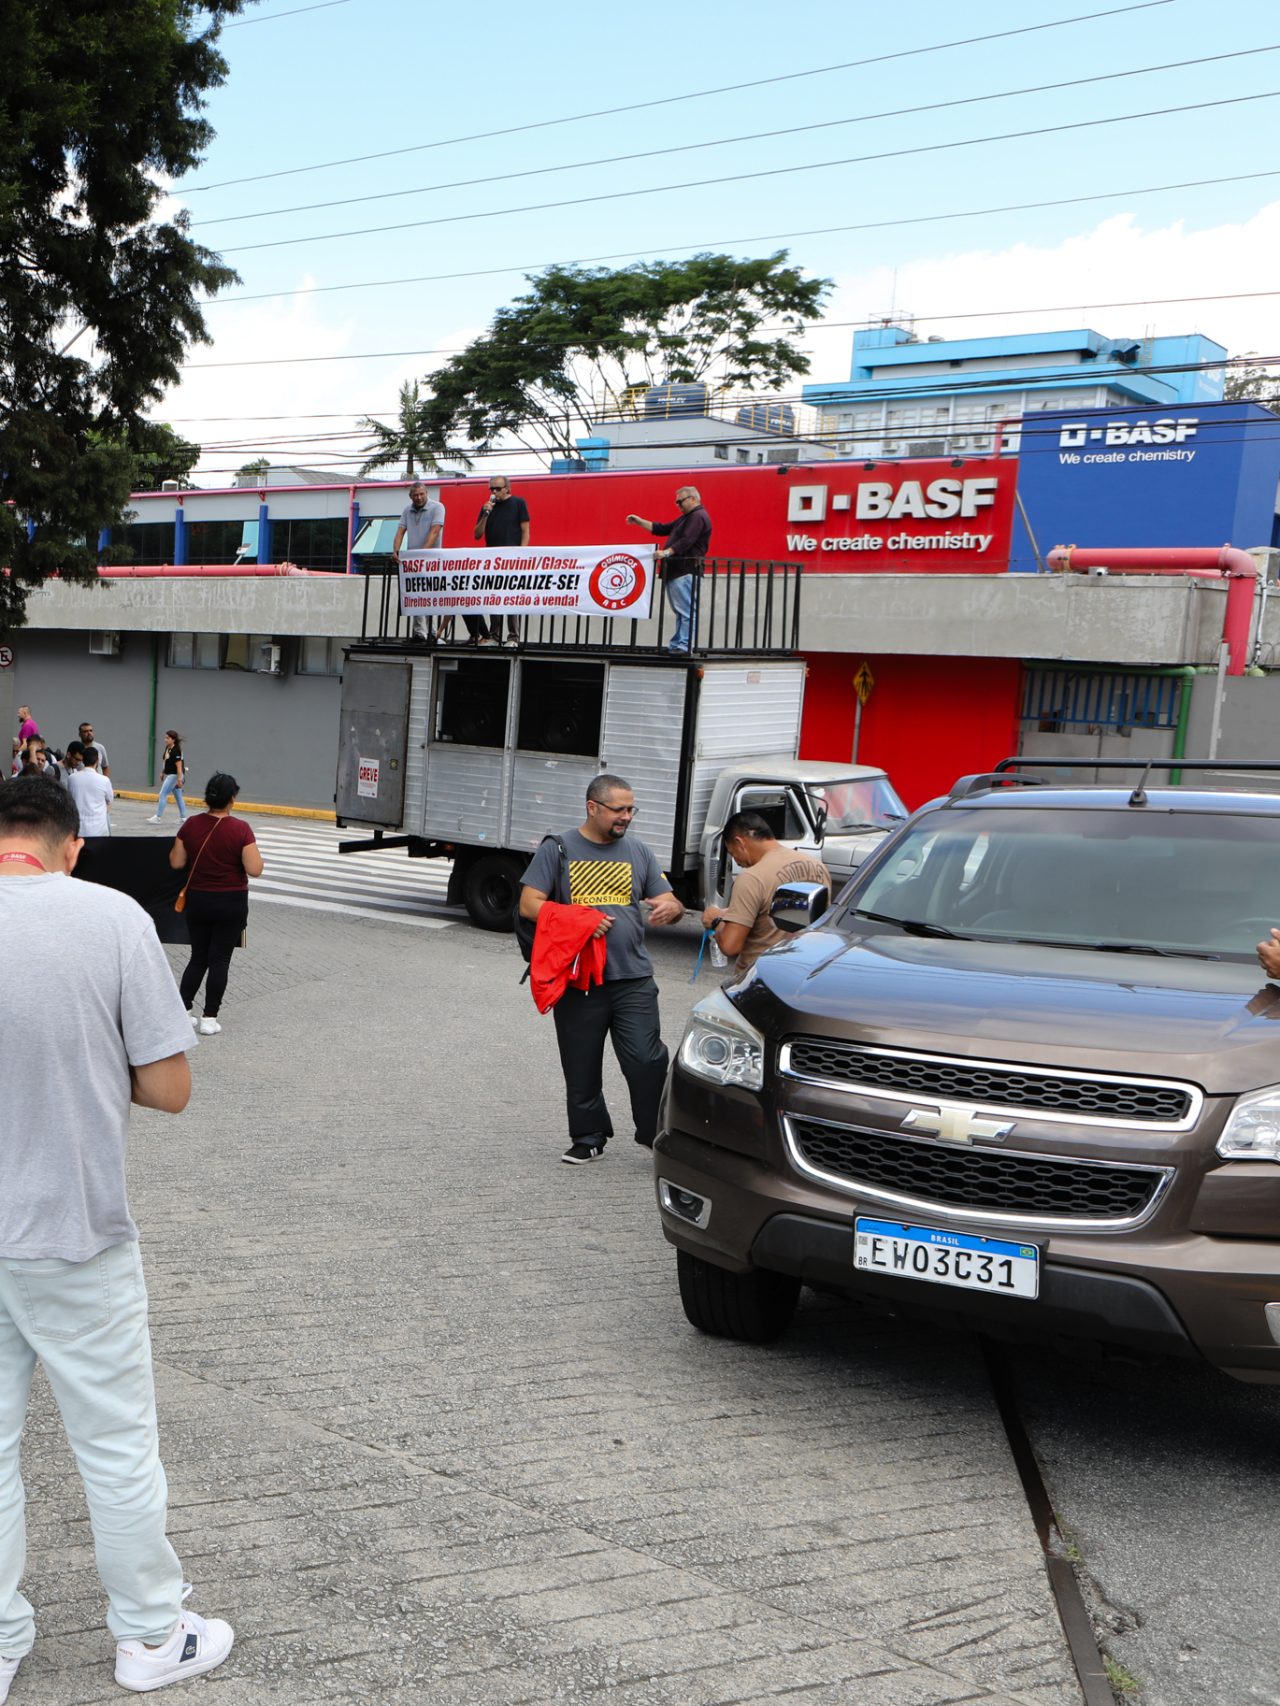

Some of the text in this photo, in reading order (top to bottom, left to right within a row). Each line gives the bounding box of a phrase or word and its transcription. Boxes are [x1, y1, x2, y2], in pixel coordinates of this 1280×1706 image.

[1105, 418, 1199, 445] BASF
[1059, 449, 1196, 464] We create chemistry
[856, 478, 998, 520] BASF
[786, 531, 993, 553] We create chemistry
[402, 559, 425, 573] BASF
[426, 558, 441, 572] vai
[442, 557, 483, 571] vender
[483, 559, 491, 570] a
[405, 574, 581, 592] DEFENDA-SE! SINDICALIZE-SE!
[404, 595, 432, 608] Direitos
[432, 597, 438, 606] e
[439, 596, 481, 608] empregos
[483, 594, 502, 606] não
[503, 594, 532, 606] estão
[542, 594, 579, 606] venda!
[360, 766, 378, 782] GREVE
[930, 1234, 960, 1246] BRASIL
[858, 1256, 868, 1266] BR
